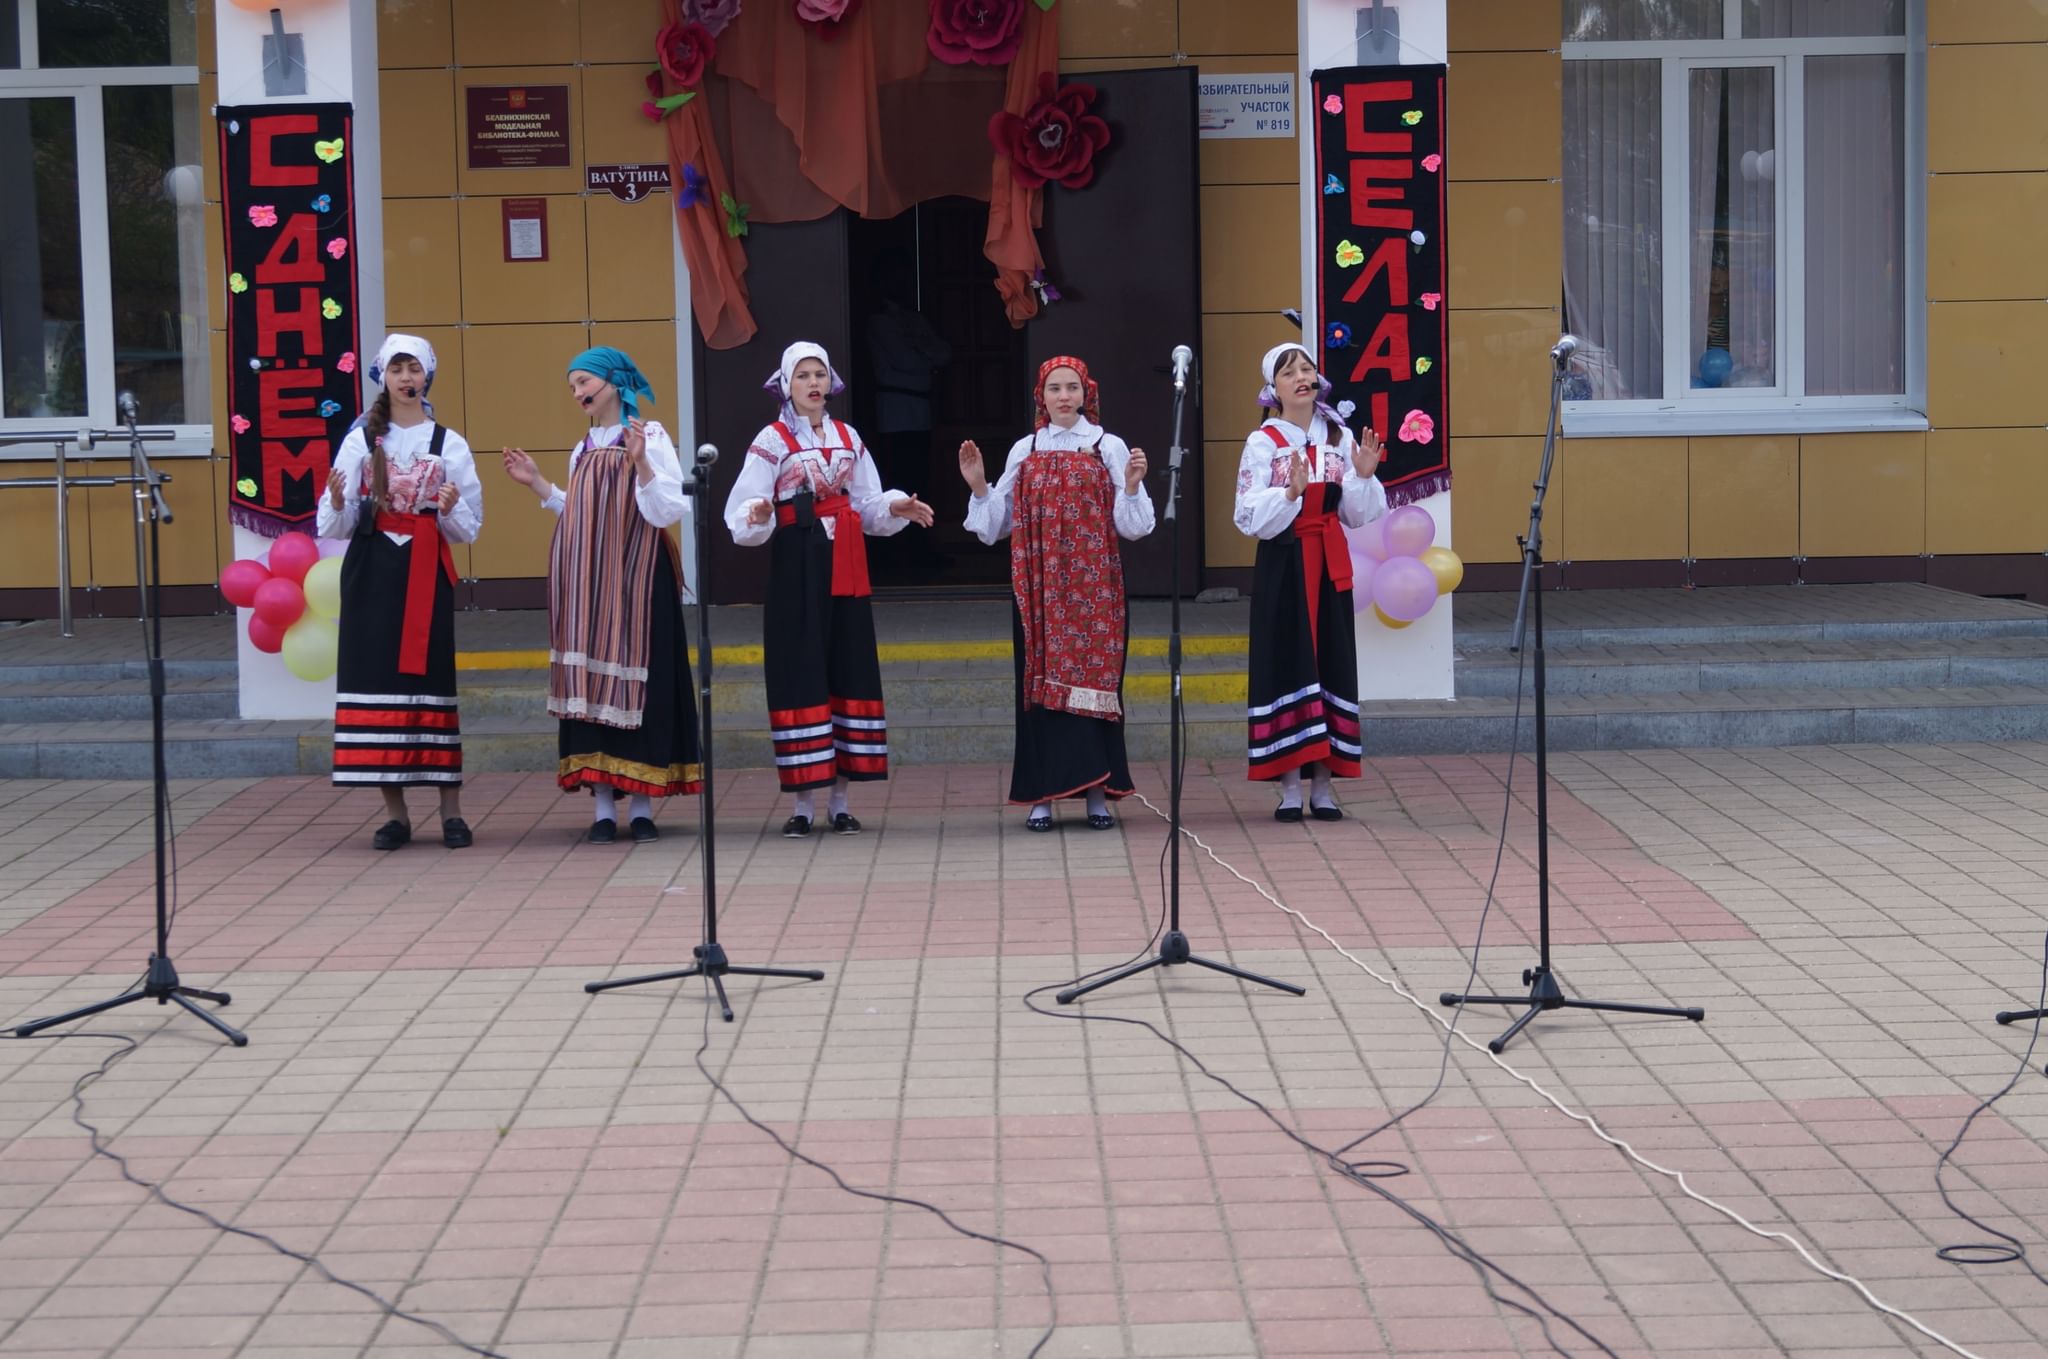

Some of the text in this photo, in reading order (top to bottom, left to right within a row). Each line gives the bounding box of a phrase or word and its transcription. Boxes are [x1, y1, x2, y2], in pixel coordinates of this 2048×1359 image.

[1240, 101, 1290, 113] УЧАСТОК
[485, 113, 551, 121] БЕЛЕНИХИНСКАЯ
[494, 122, 542, 130] МОДЕЛЬНАЯ
[1256, 119, 1290, 130] № 819
[477, 131, 560, 139] БИБЛИОТЕКА-ФИЛИАЛ
[591, 171, 669, 183] ВАТУТИНА
[625, 183, 637, 201] 3
[1341, 80, 1414, 462] СЕЛА!
